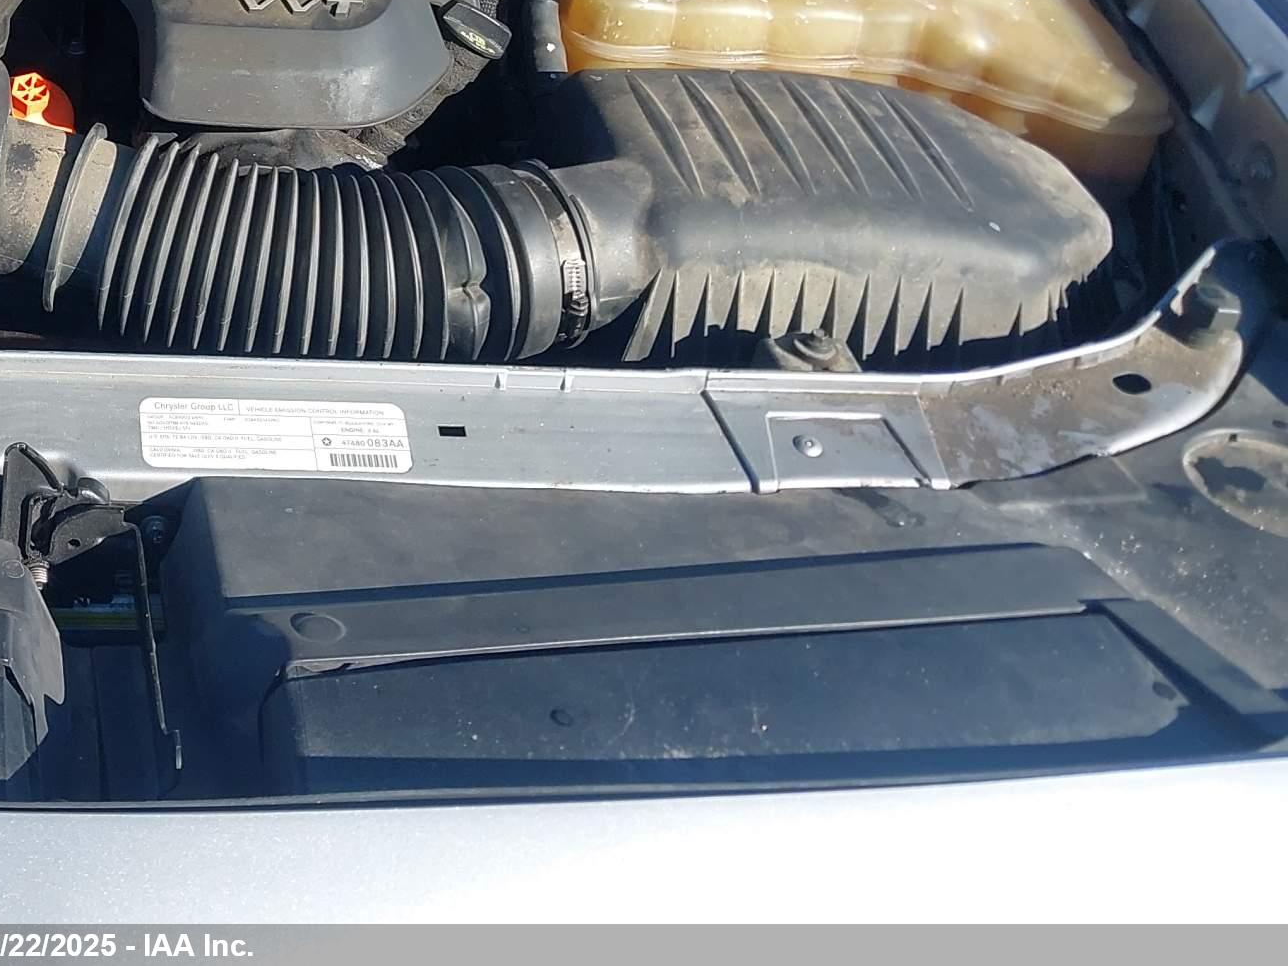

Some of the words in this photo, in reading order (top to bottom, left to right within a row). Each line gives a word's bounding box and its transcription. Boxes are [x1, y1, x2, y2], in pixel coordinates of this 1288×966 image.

[154, 401, 187, 411] Chrysler
[190, 402, 216, 411] Group
[218, 403, 234, 411] LLC
